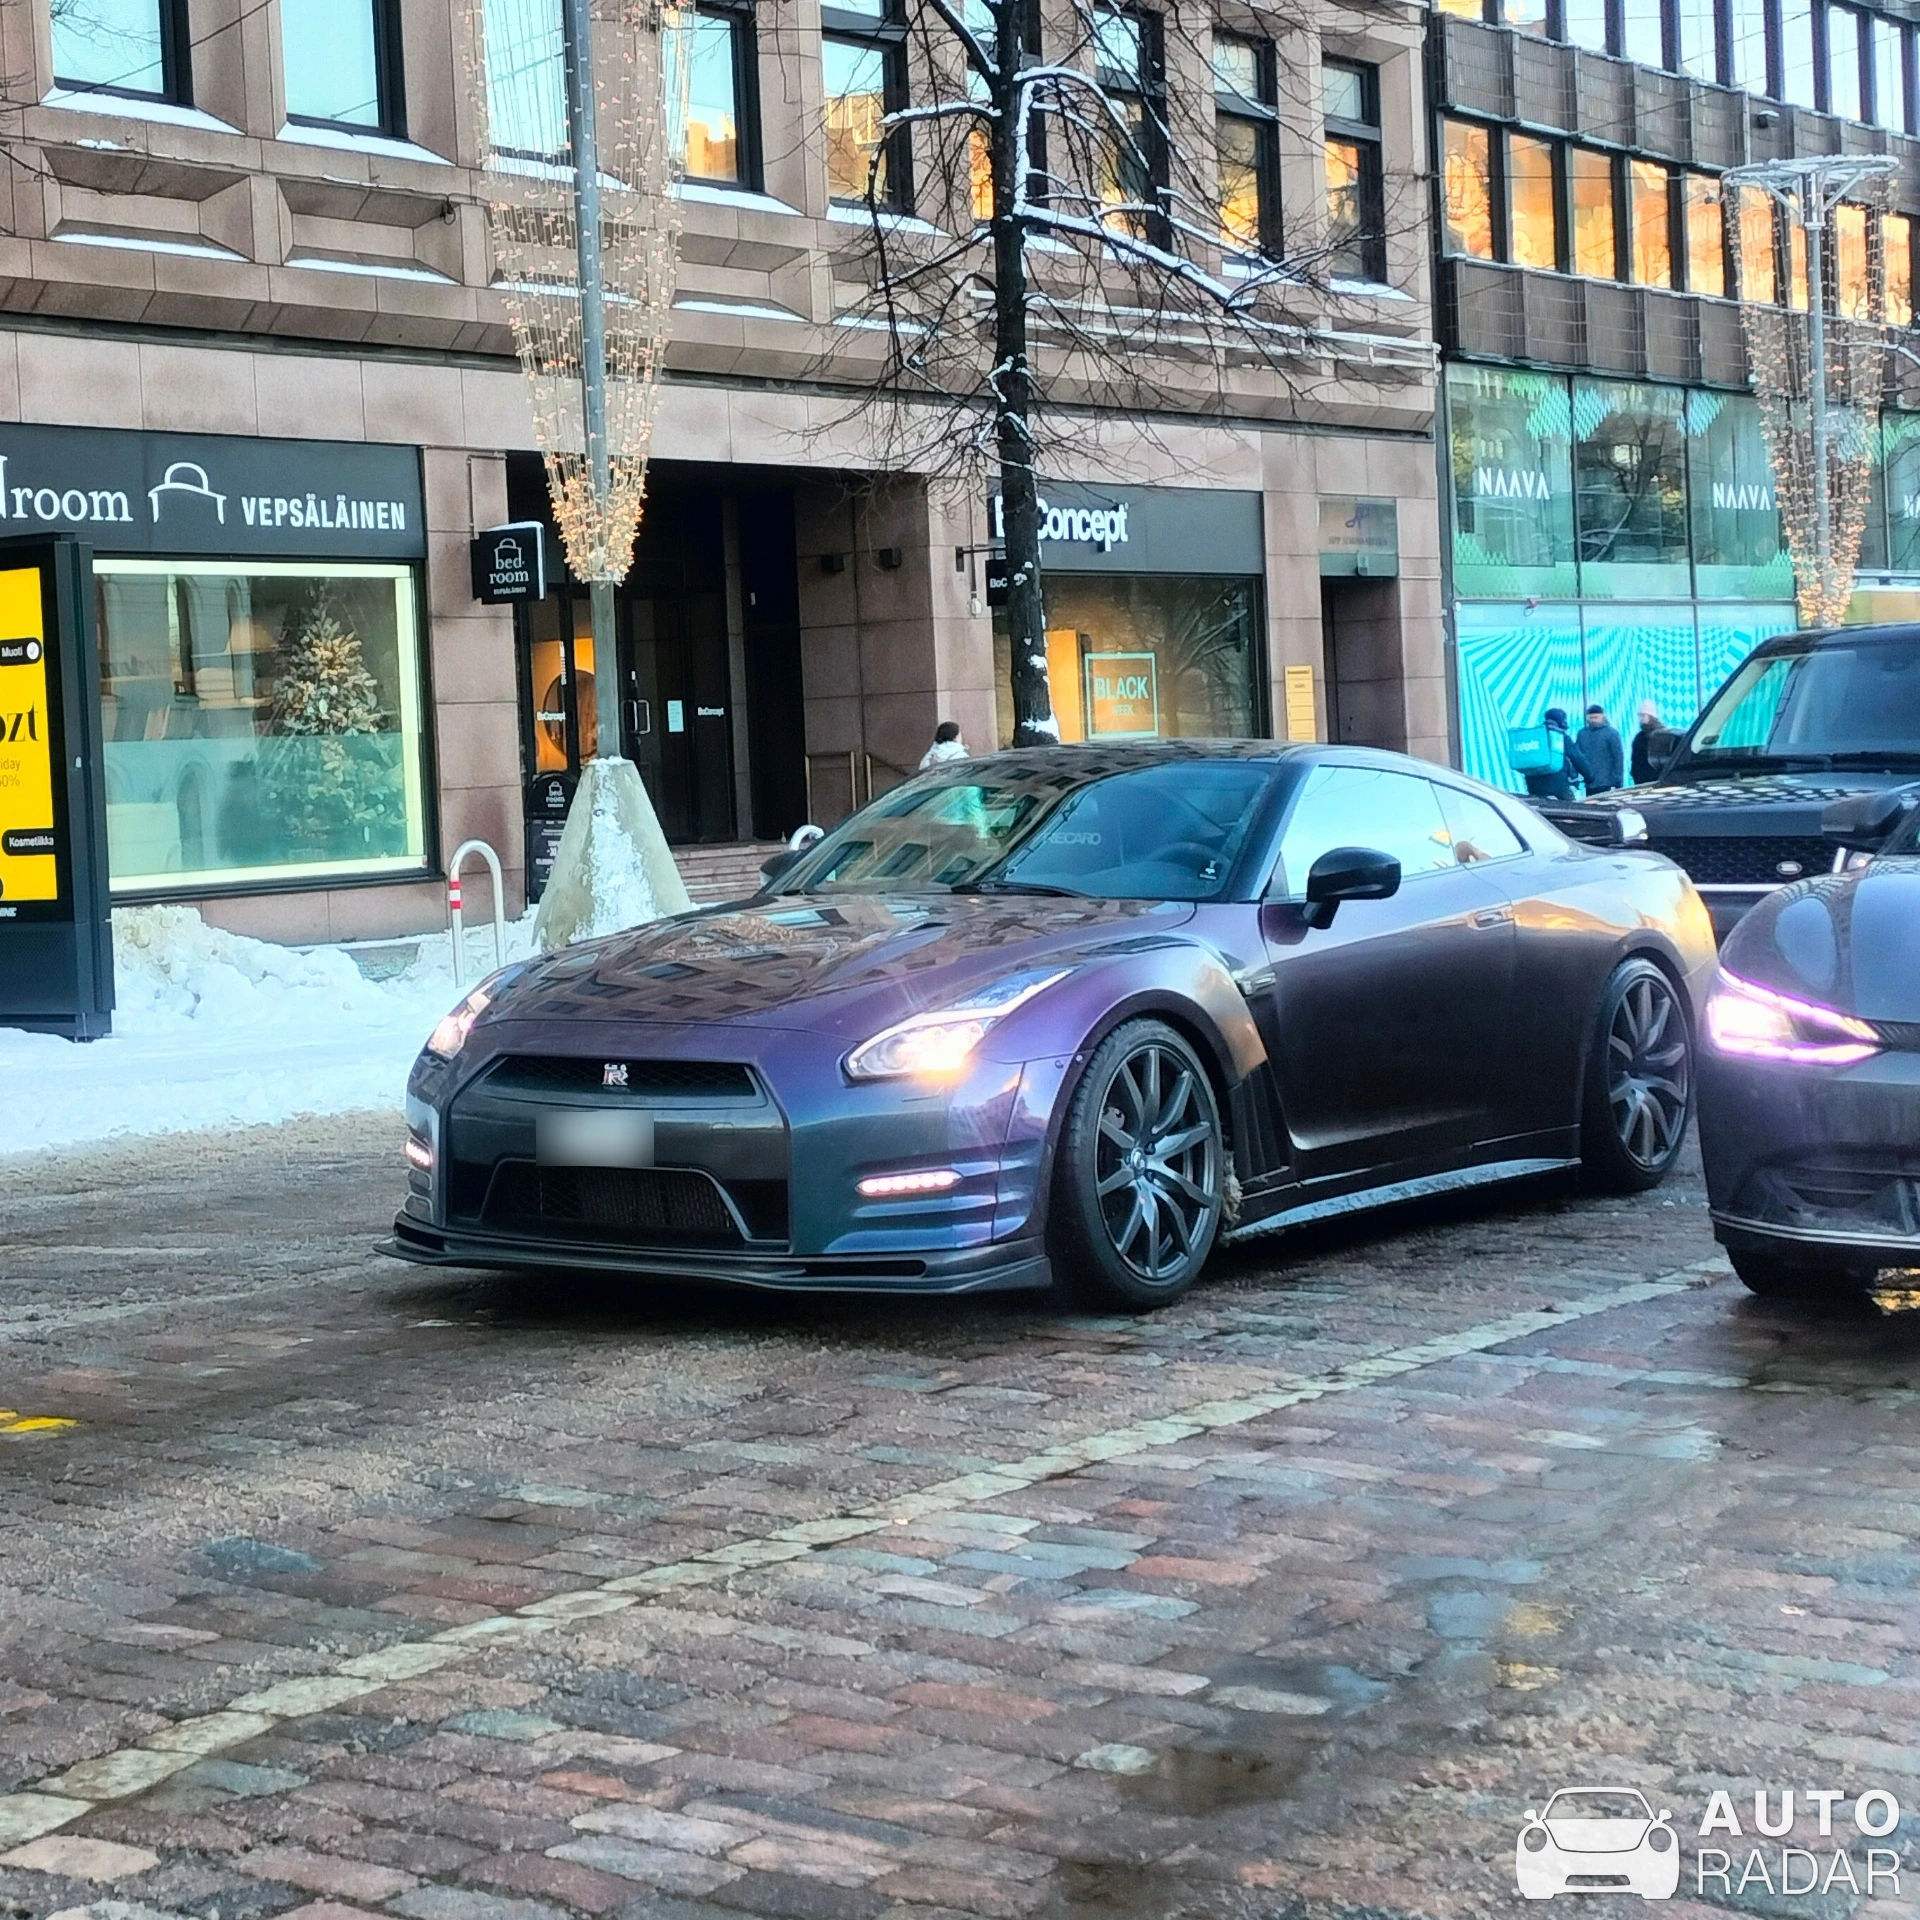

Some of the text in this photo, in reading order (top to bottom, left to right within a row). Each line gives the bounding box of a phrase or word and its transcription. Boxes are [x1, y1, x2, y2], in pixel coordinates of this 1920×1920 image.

[1479, 467, 1550, 500] NAAVA
[1713, 482, 1771, 511] NAAVA
[241, 493, 405, 530] VEPSÄLÄINEN
[489, 571, 529, 584] room
[2, 645, 23, 657] Muoti
[1095, 676, 1149, 700] BLACK
[0, 775, 20, 787] 0%
[9, 835, 54, 847] Kosmetiikka
